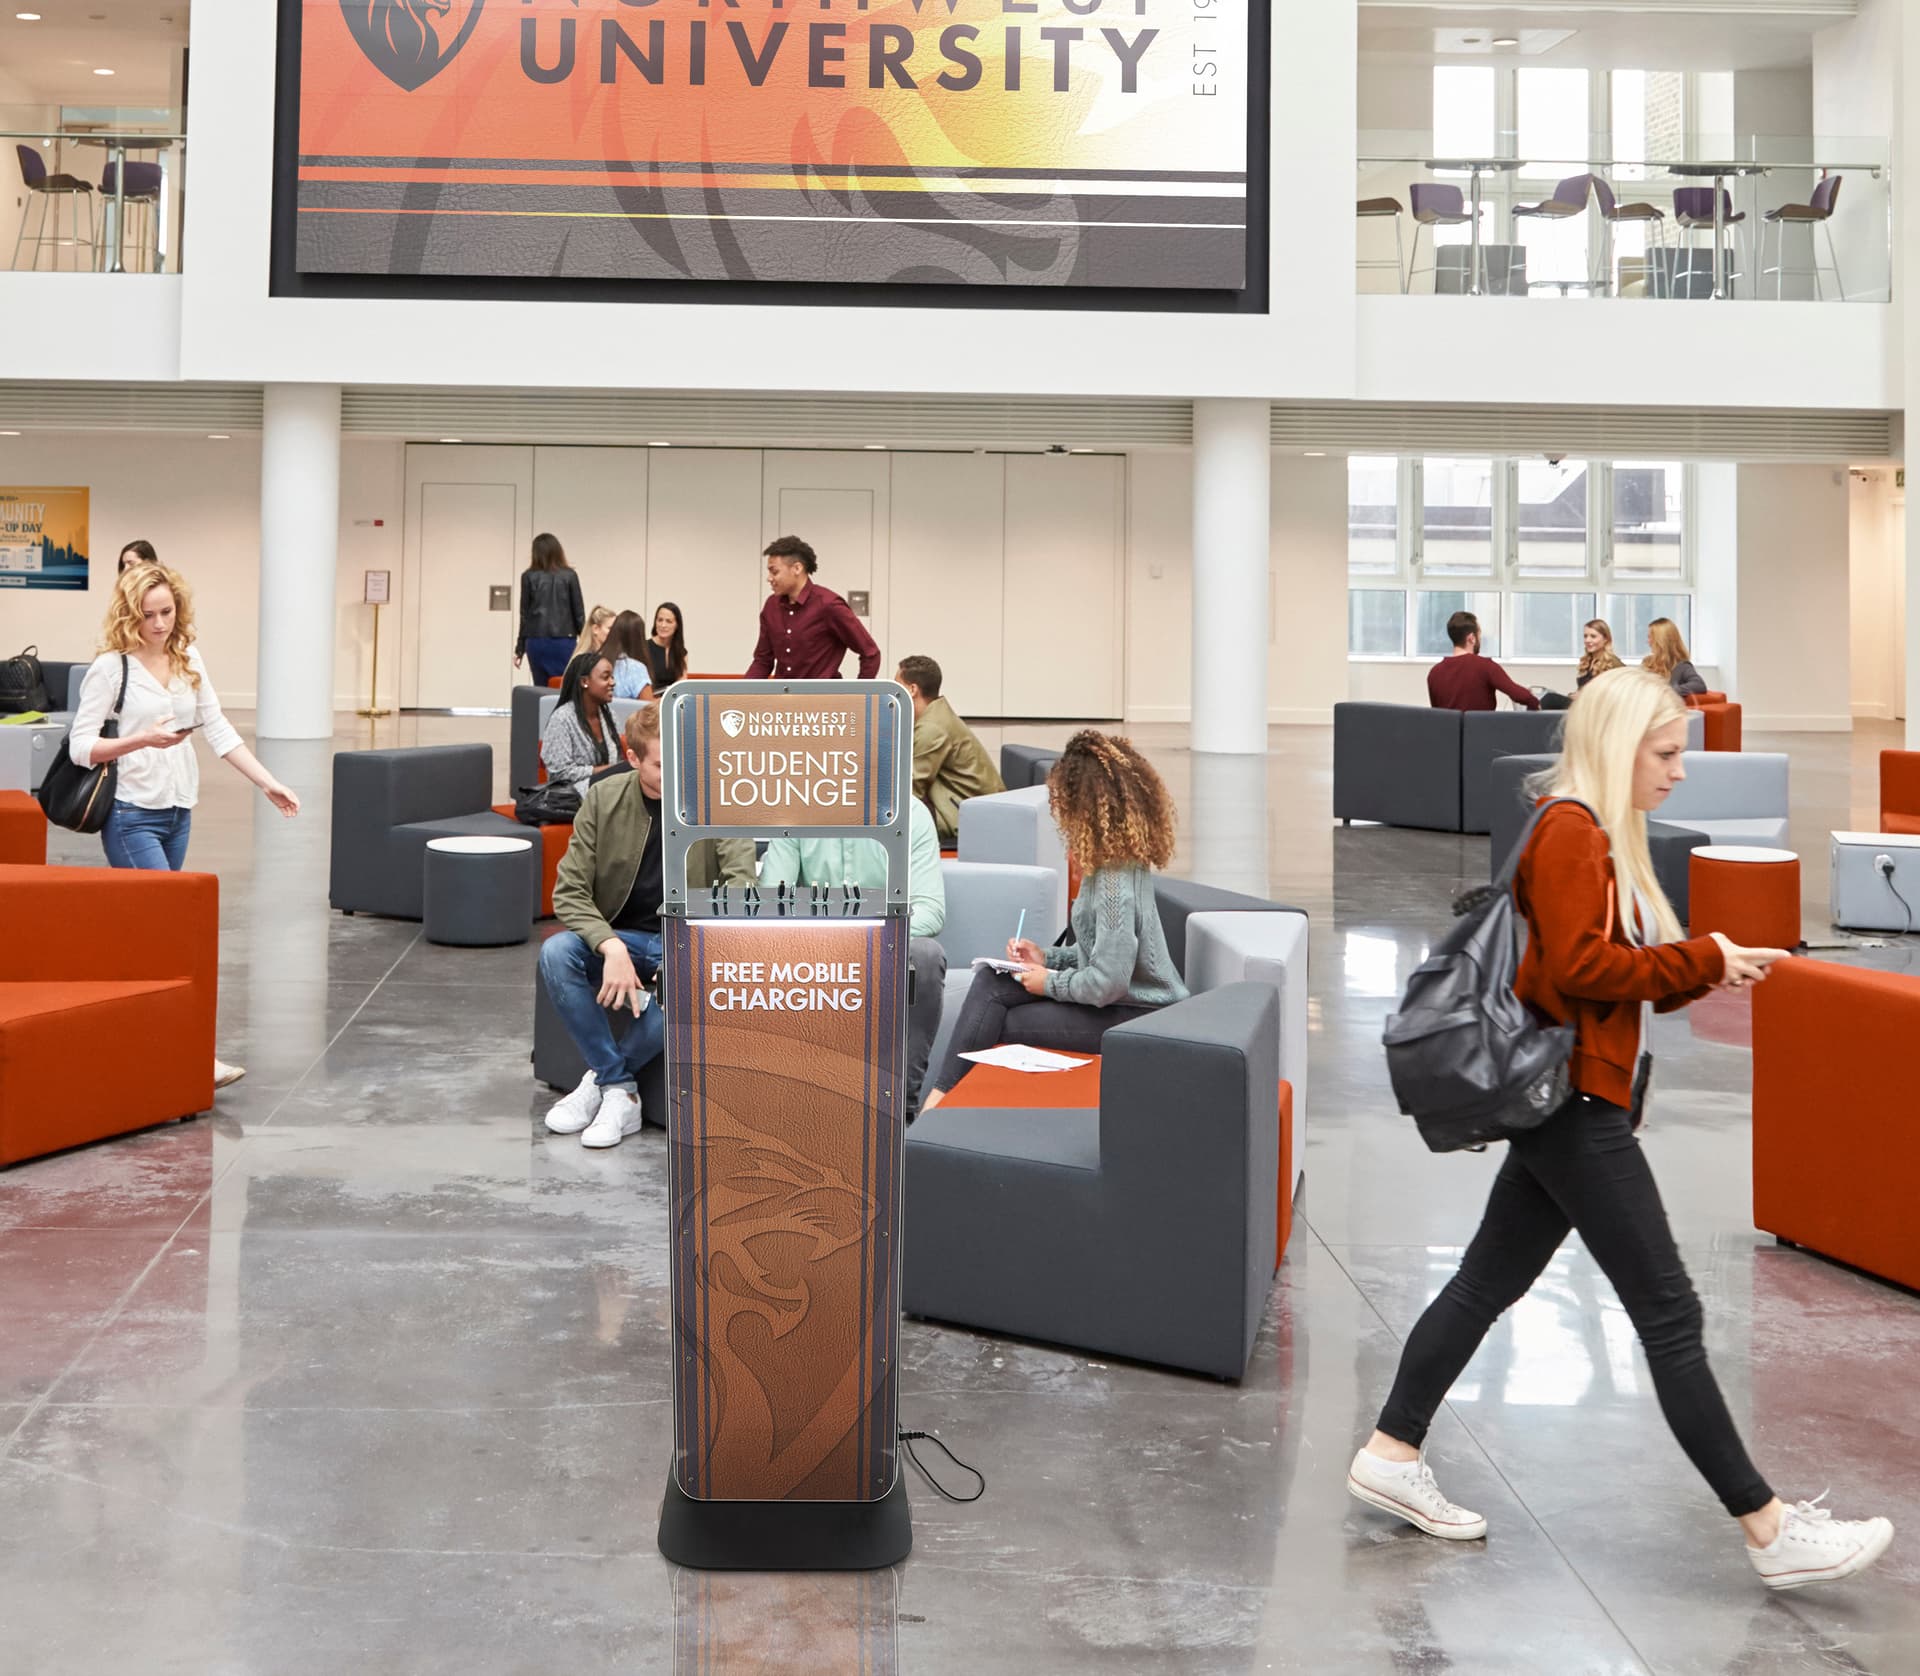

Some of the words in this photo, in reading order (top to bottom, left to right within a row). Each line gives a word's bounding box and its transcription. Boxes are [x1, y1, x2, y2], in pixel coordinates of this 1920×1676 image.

[520, 17, 1161, 94] UNIVERSITY
[1193, 43, 1217, 95] EST
[22, 523, 42, 533] DAY
[749, 711, 848, 724] NORTHWEST
[749, 724, 847, 736] UNIVERSITY
[718, 751, 858, 776] STUDENTS
[720, 778, 857, 806] LOUNGE
[711, 962, 765, 983] FREE
[769, 962, 861, 983] MOBILE
[709, 987, 863, 1011] CHARGING
